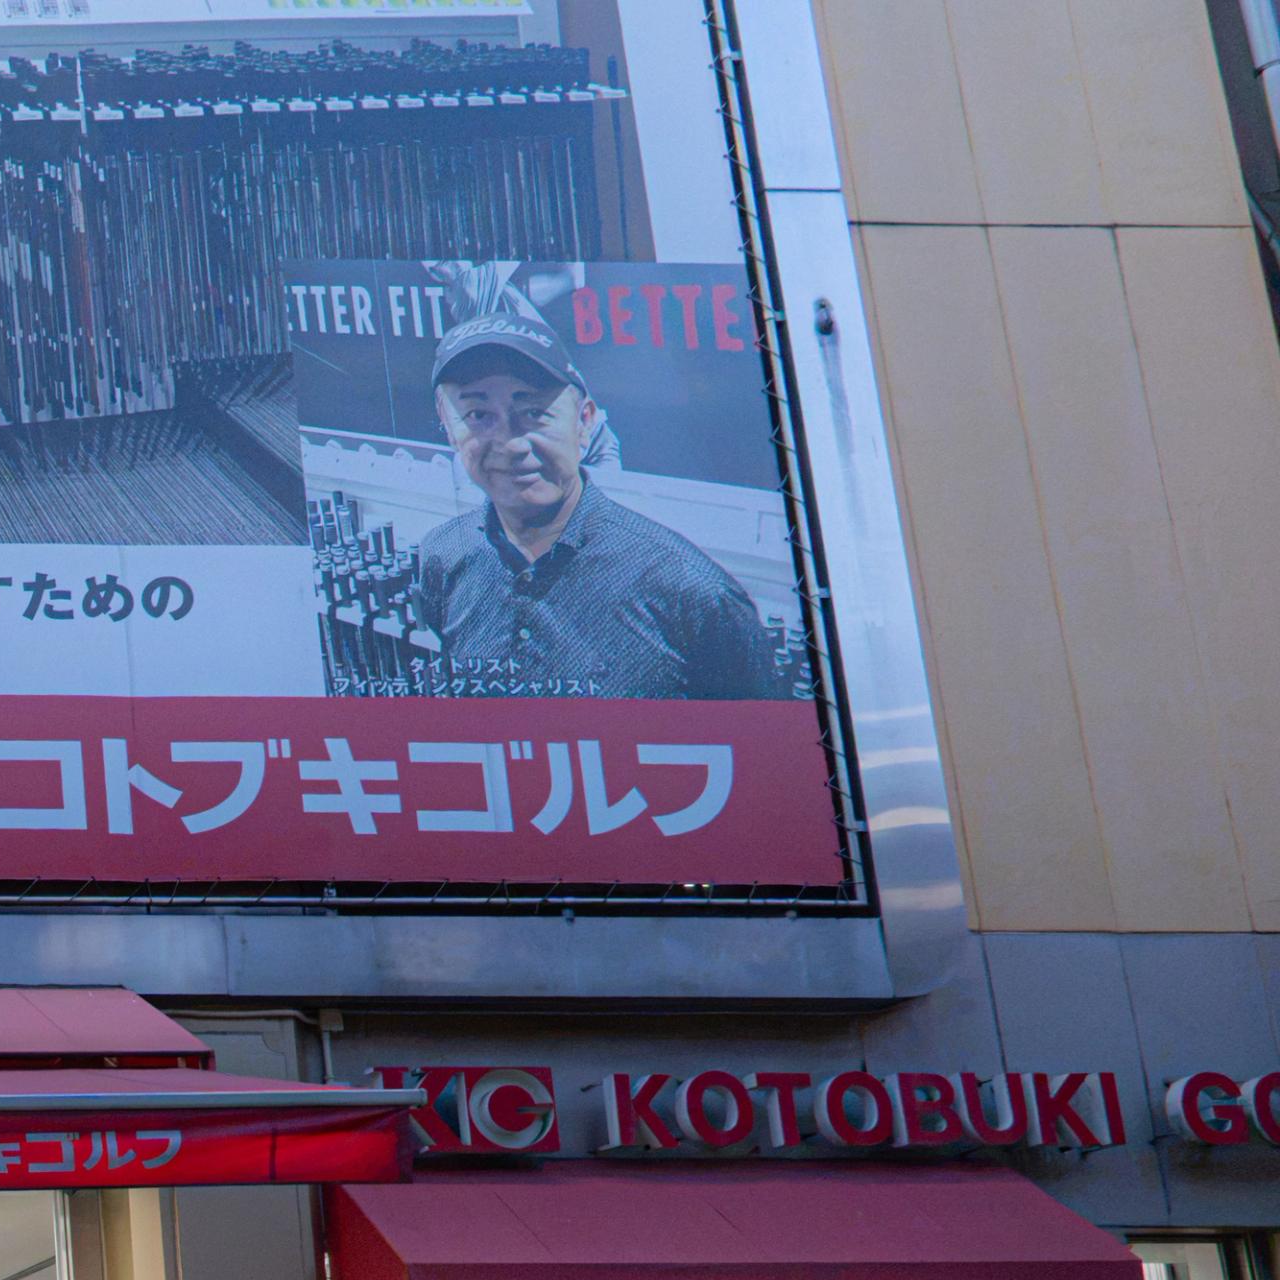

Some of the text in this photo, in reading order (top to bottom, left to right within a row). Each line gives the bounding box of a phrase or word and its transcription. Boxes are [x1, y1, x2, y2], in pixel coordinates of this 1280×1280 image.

[389, 286, 443, 338] FIT
[573, 284, 760, 352] BETTE
[409, 656, 521, 674] タイトリスト
[604, 1070, 1128, 1149] KOTOBUKI
